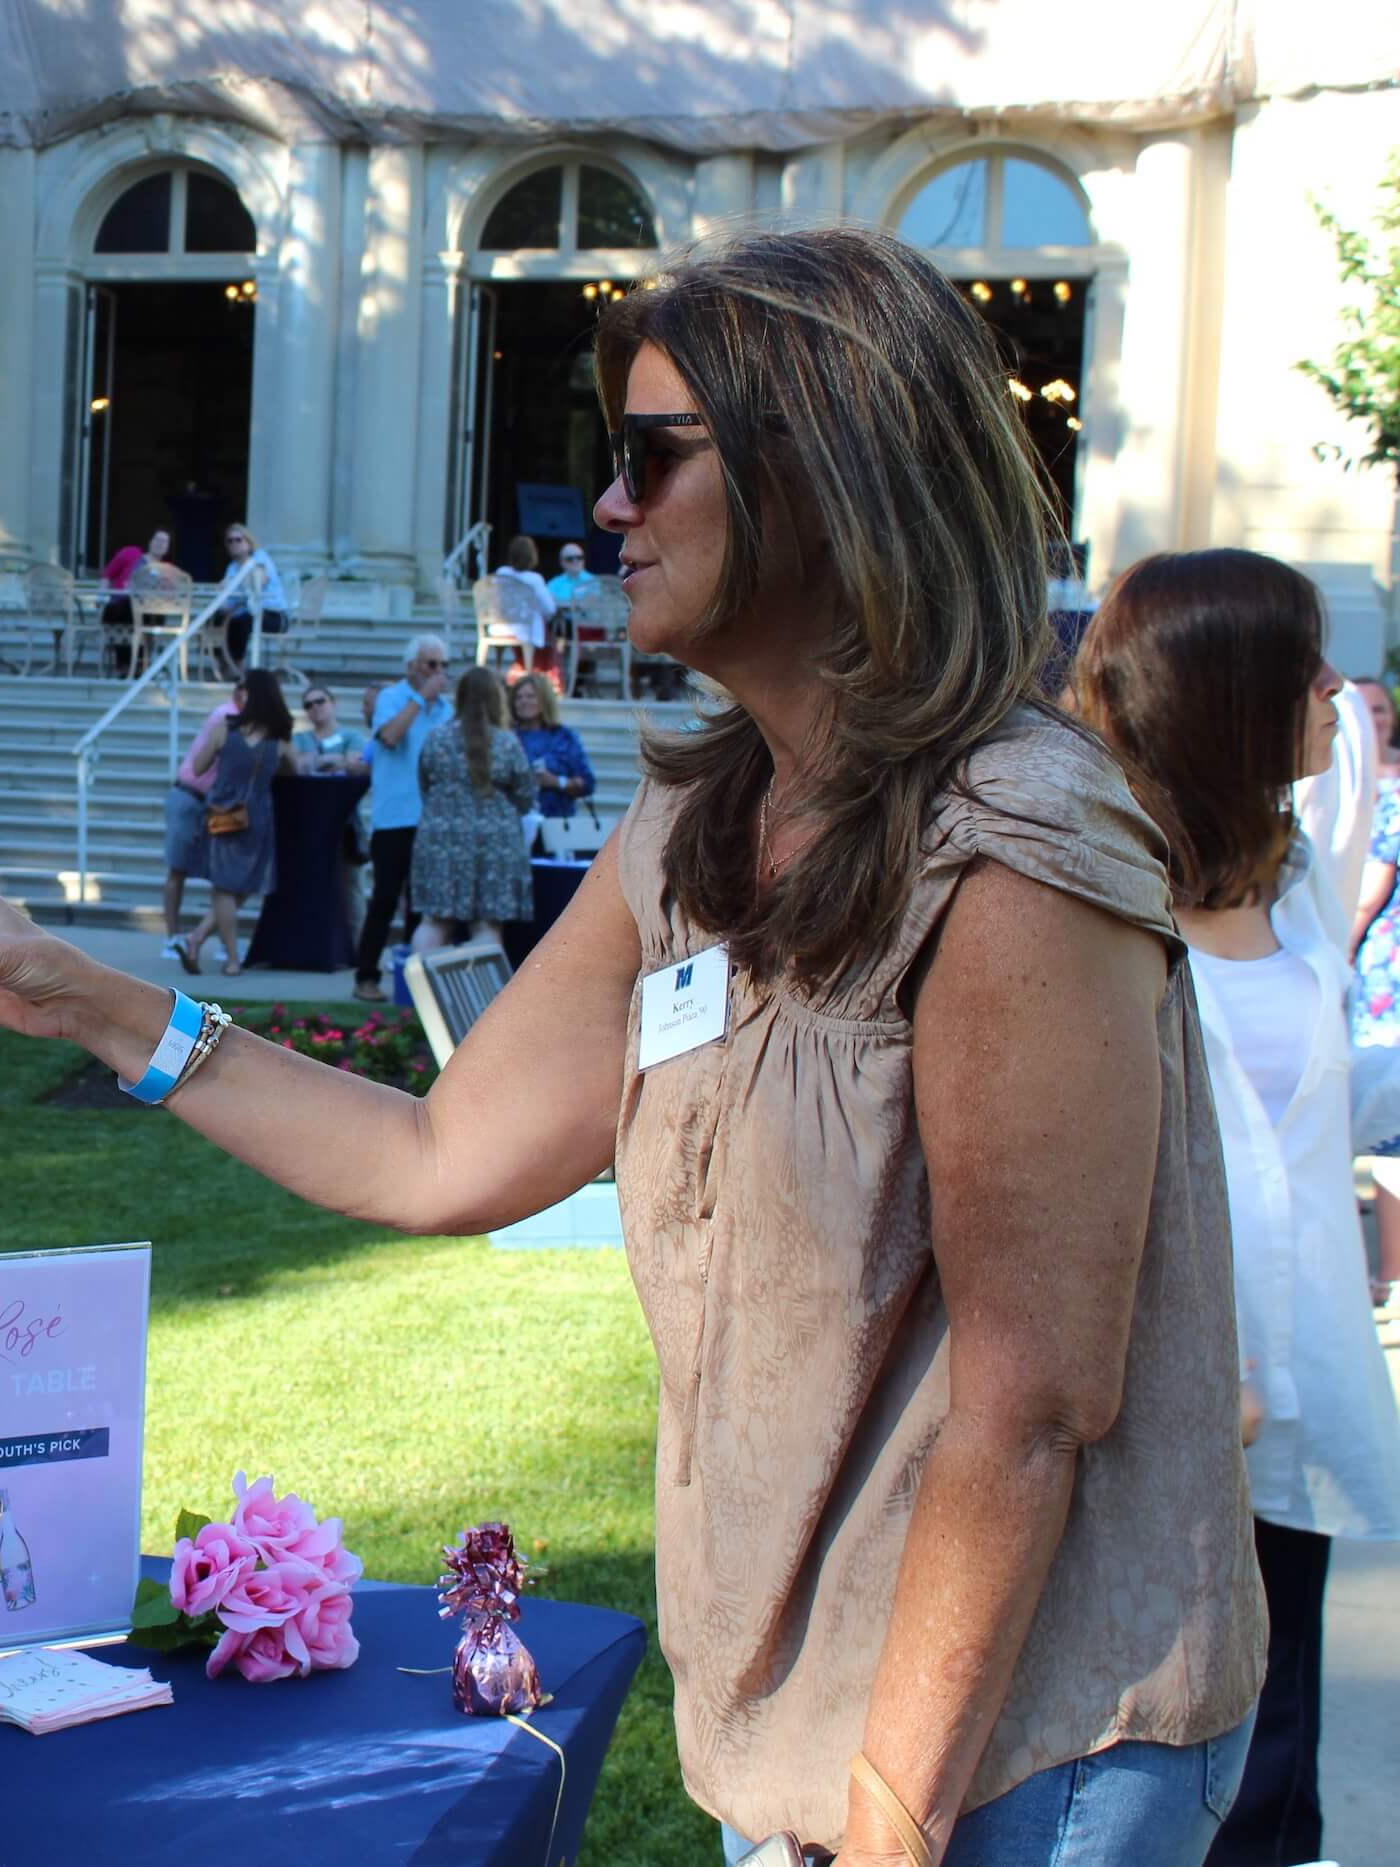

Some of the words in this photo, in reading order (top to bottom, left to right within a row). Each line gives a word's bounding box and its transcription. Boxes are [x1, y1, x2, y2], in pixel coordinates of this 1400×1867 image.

[674, 963, 694, 992] M
[672, 999, 694, 1014] Kerry
[10, 1366, 97, 1396] TABLE
[49, 1438, 81, 1452] PICK
